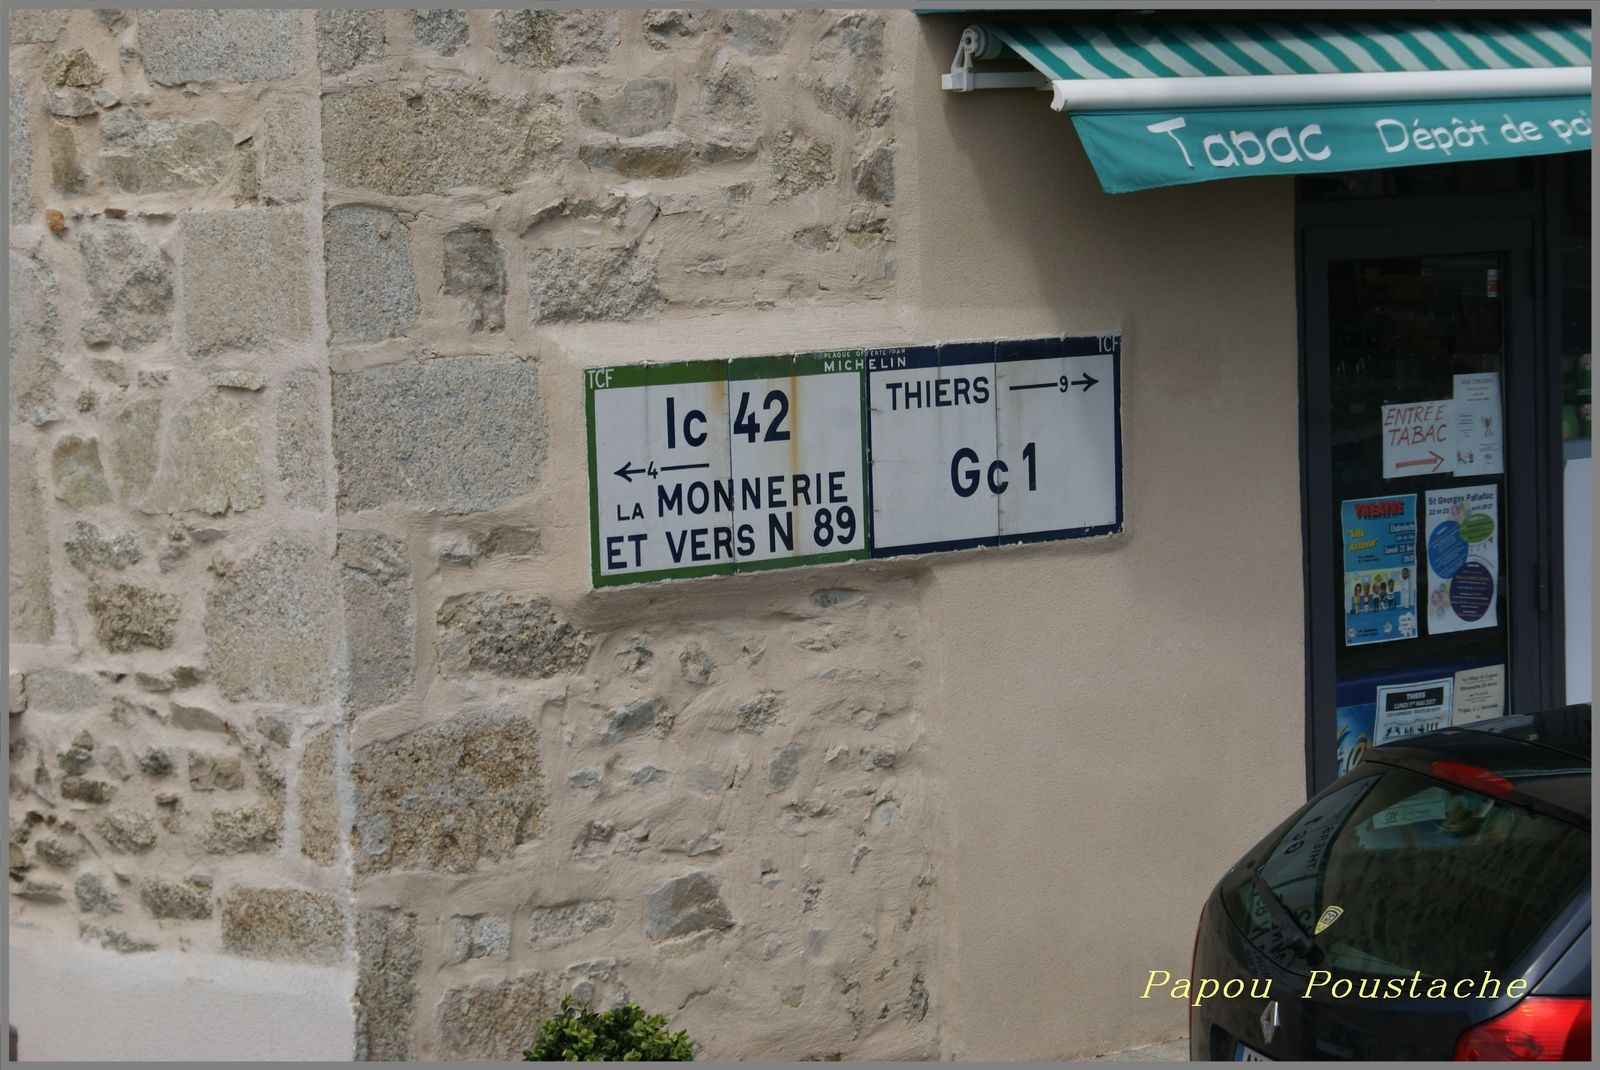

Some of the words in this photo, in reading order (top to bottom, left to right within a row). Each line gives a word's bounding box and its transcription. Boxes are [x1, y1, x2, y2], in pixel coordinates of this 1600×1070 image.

[1147, 117, 1331, 168] Tabac
[1375, 117, 1487, 157] Dépôt
[1500, 115, 1543, 144] de
[587, 368, 614, 389] TCF
[824, 356, 906, 372] MICHELIN
[886, 376, 989, 411] THIERS
[1059, 375, 1068, 393] 9
[733, 389, 790, 443] 42
[1384, 403, 1446, 427] ENTRÉE
[1388, 424, 1448, 447] TABAC
[647, 460, 658, 479] 4
[950, 447, 1009, 498] Gc
[1022, 442, 1037, 492] 1
[617, 502, 644, 521] LA
[657, 471, 848, 518] MONNERIE
[1438, 495, 1465, 505] Georges
[606, 533, 648, 570] ET
[665, 523, 756, 564] VERS
[769, 511, 794, 553] N
[813, 505, 857, 548] 89
